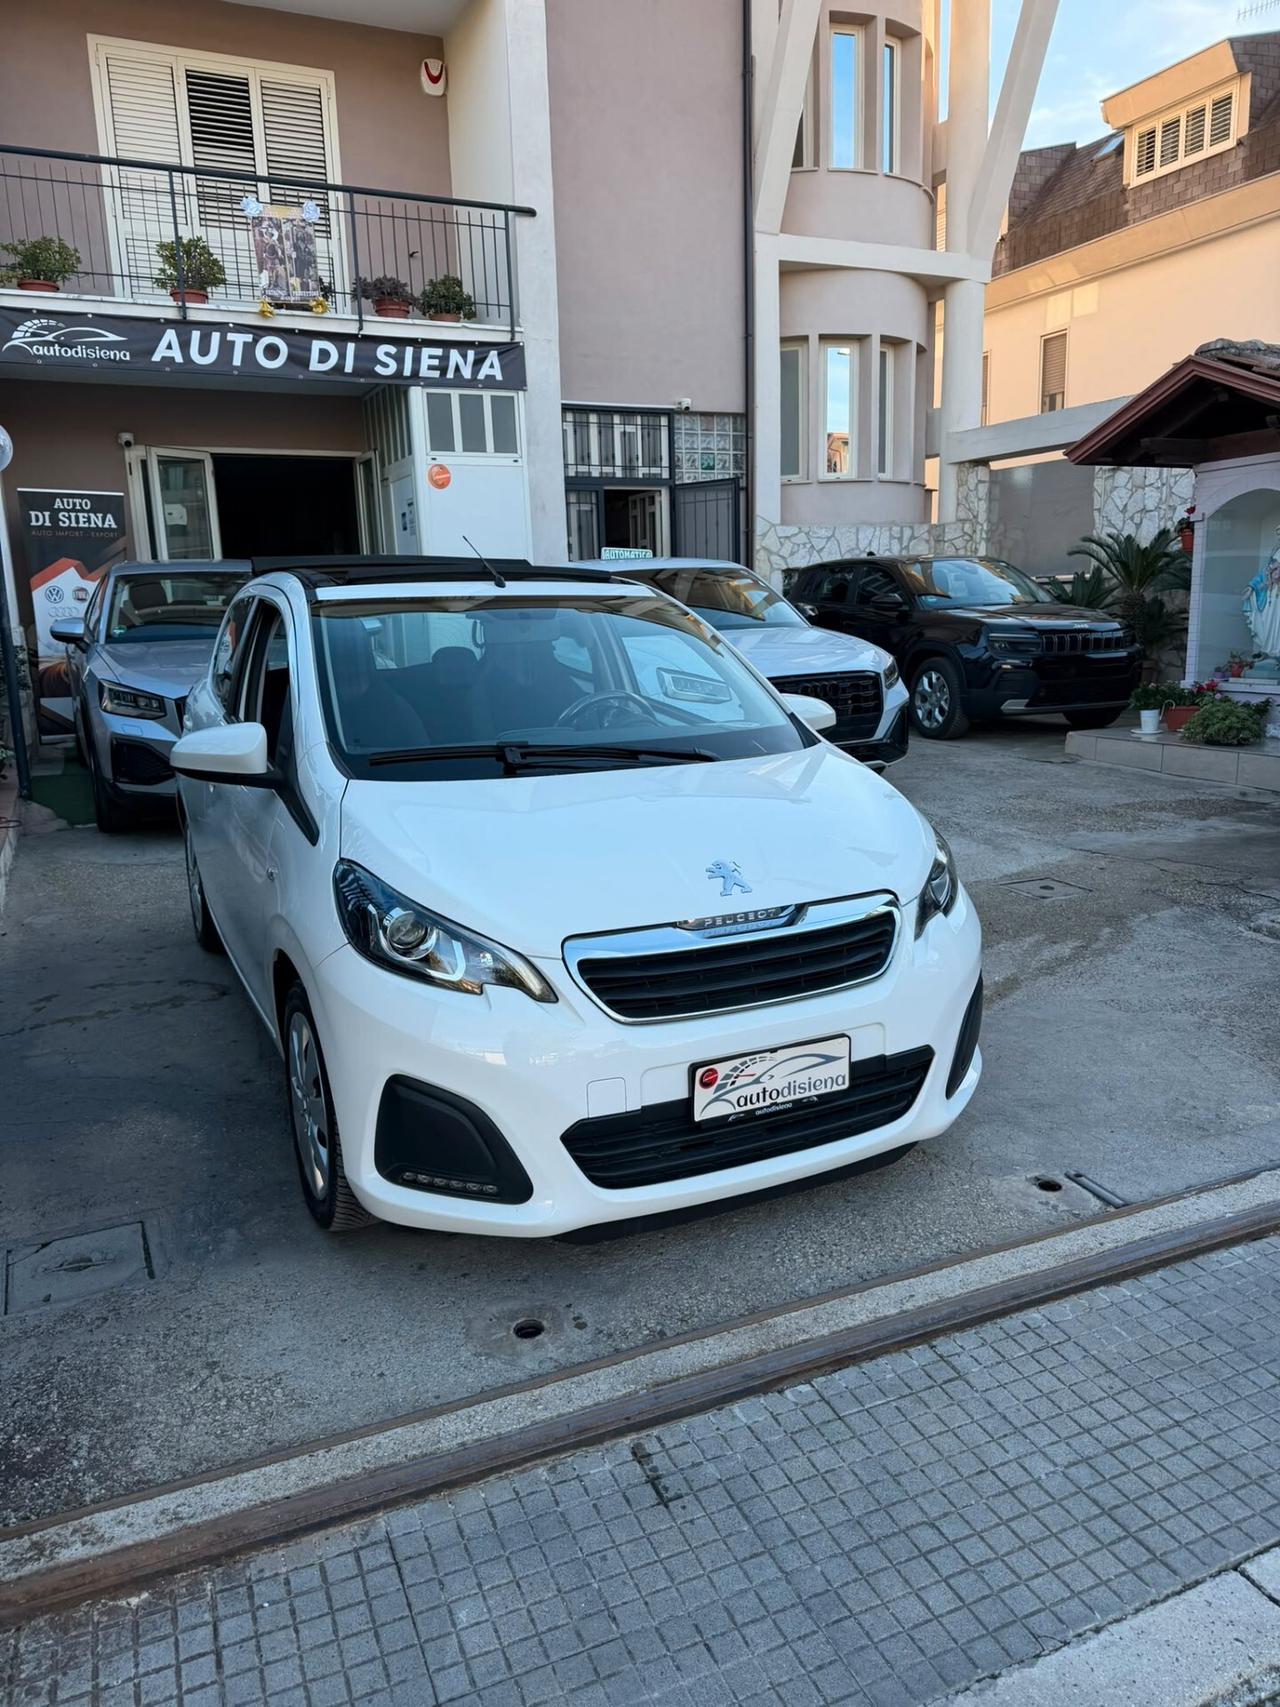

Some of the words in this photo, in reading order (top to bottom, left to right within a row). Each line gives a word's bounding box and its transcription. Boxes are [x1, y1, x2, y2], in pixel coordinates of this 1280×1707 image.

[32, 341, 131, 362] autodisiena
[151, 328, 289, 369] AUTO
[309, 340, 355, 374] DI
[374, 343, 504, 381] SIENA
[53, 498, 91, 510] AUTO
[29, 511, 51, 526] DI
[58, 512, 117, 528] SIENA
[704, 909, 776, 927] PEUGEOT
[736, 1073, 847, 1109] autodisiena
